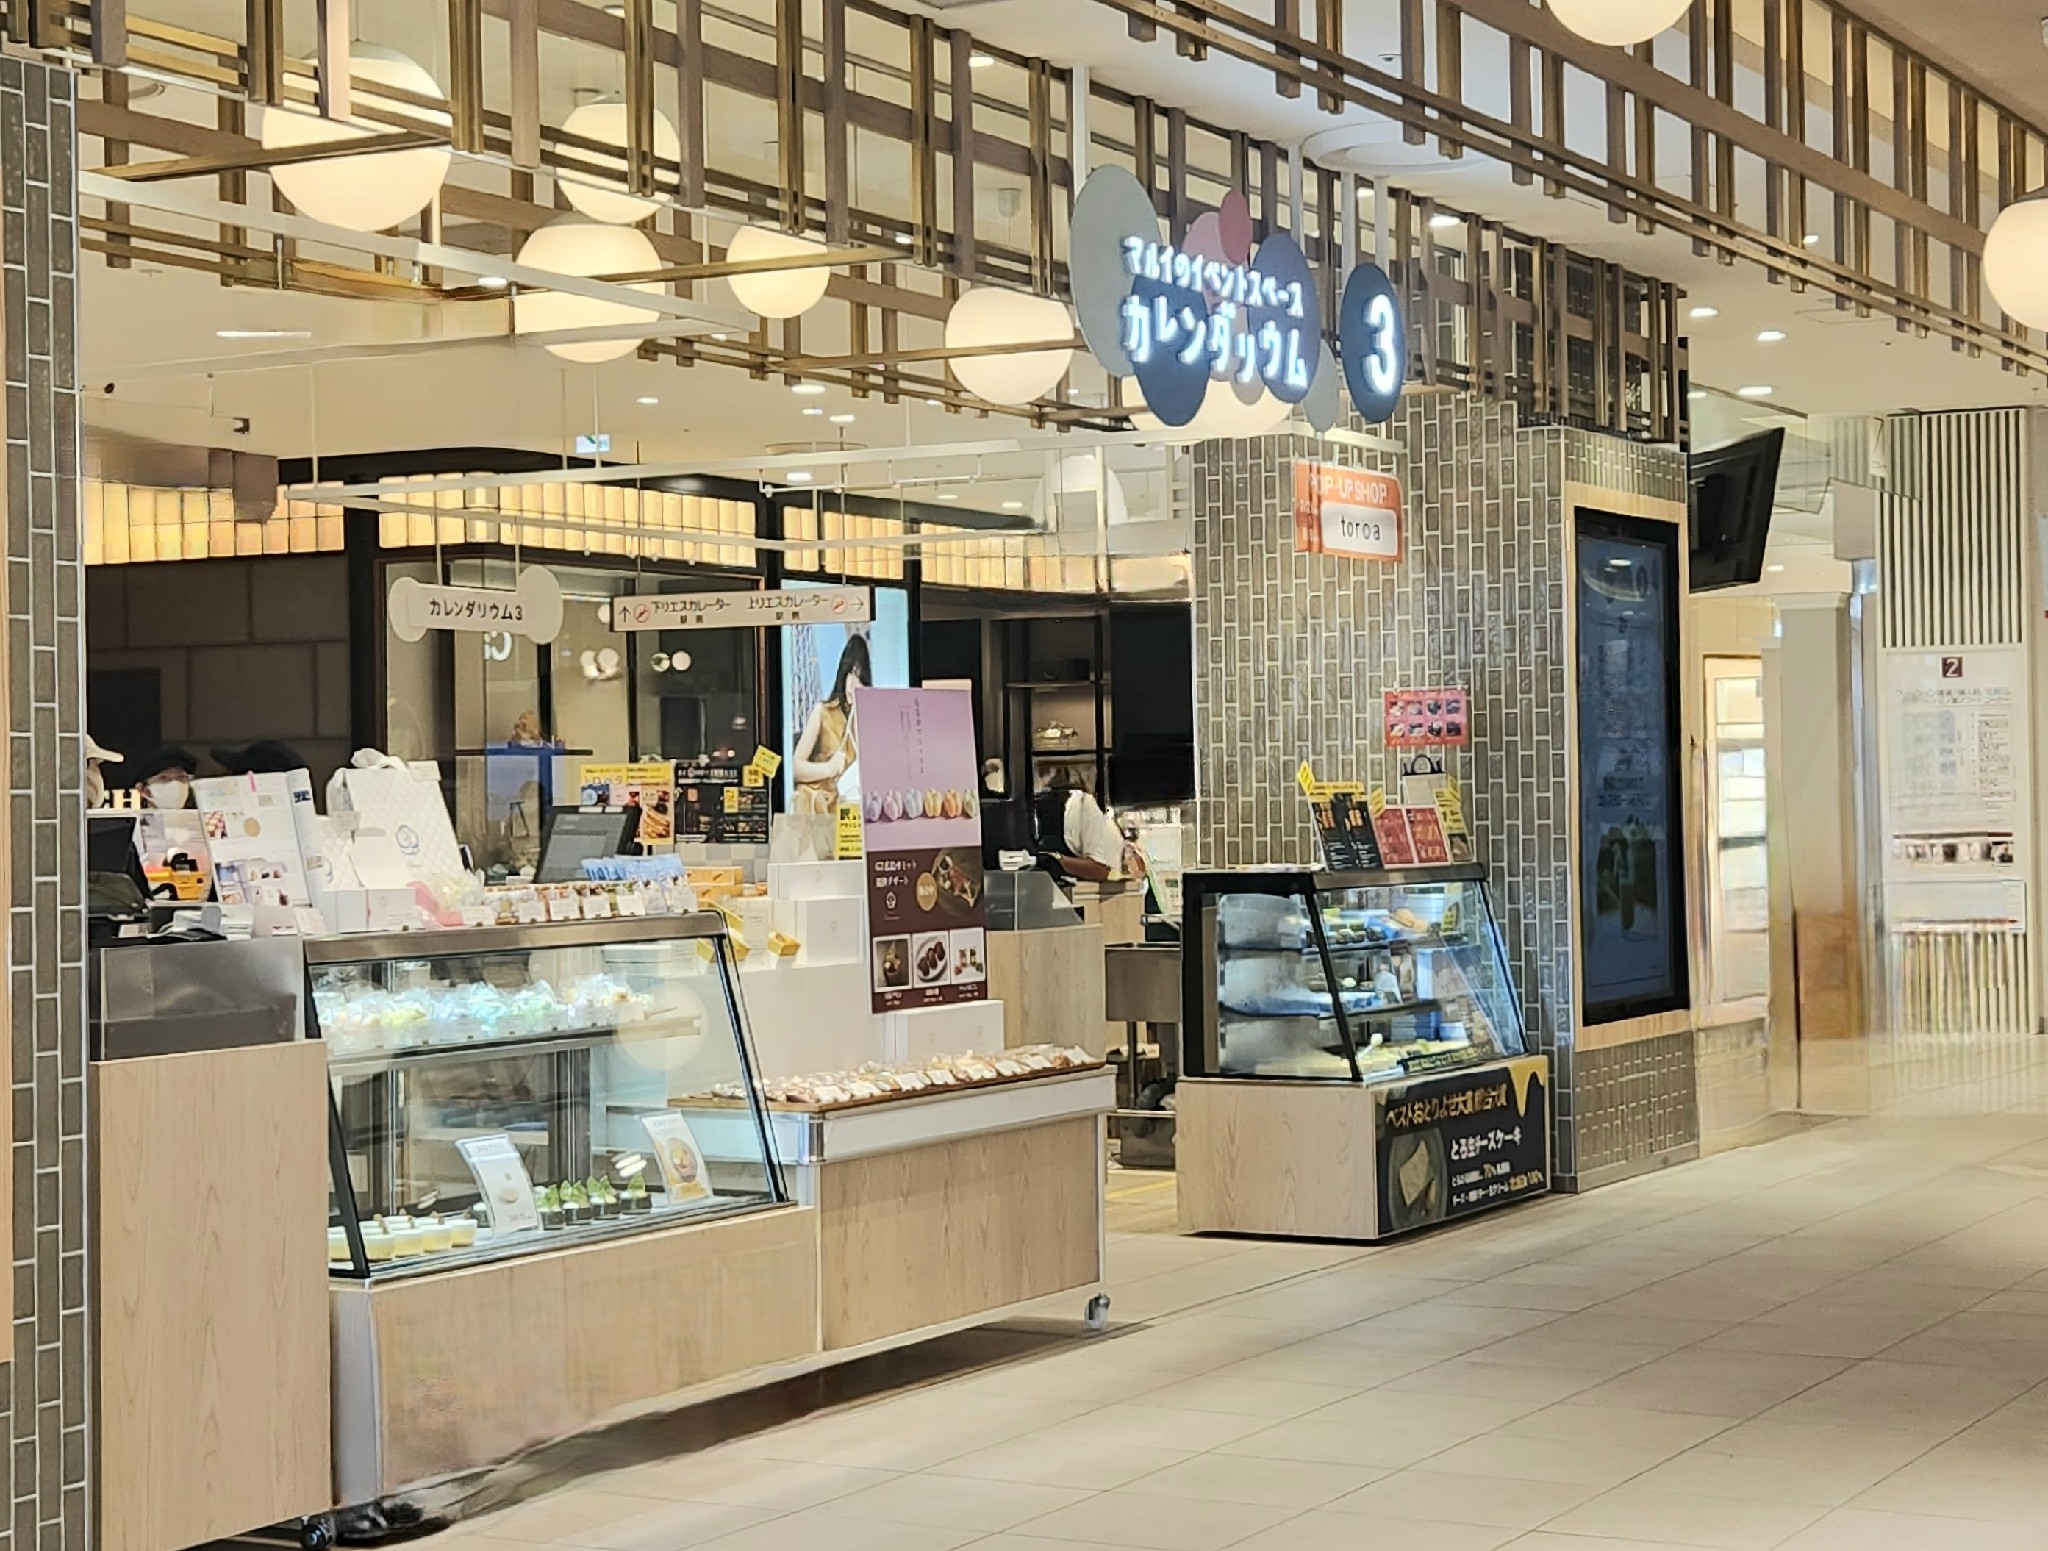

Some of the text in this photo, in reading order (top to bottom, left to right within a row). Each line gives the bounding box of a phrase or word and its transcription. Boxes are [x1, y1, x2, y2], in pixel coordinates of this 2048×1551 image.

[1123, 236, 1303, 318] マルイのイベントスペース
[1122, 294, 1307, 387] カレンダリウム
[1363, 293, 1398, 395] 3
[1341, 514, 1381, 542] toroa
[1945, 657, 1960, 678] 2
